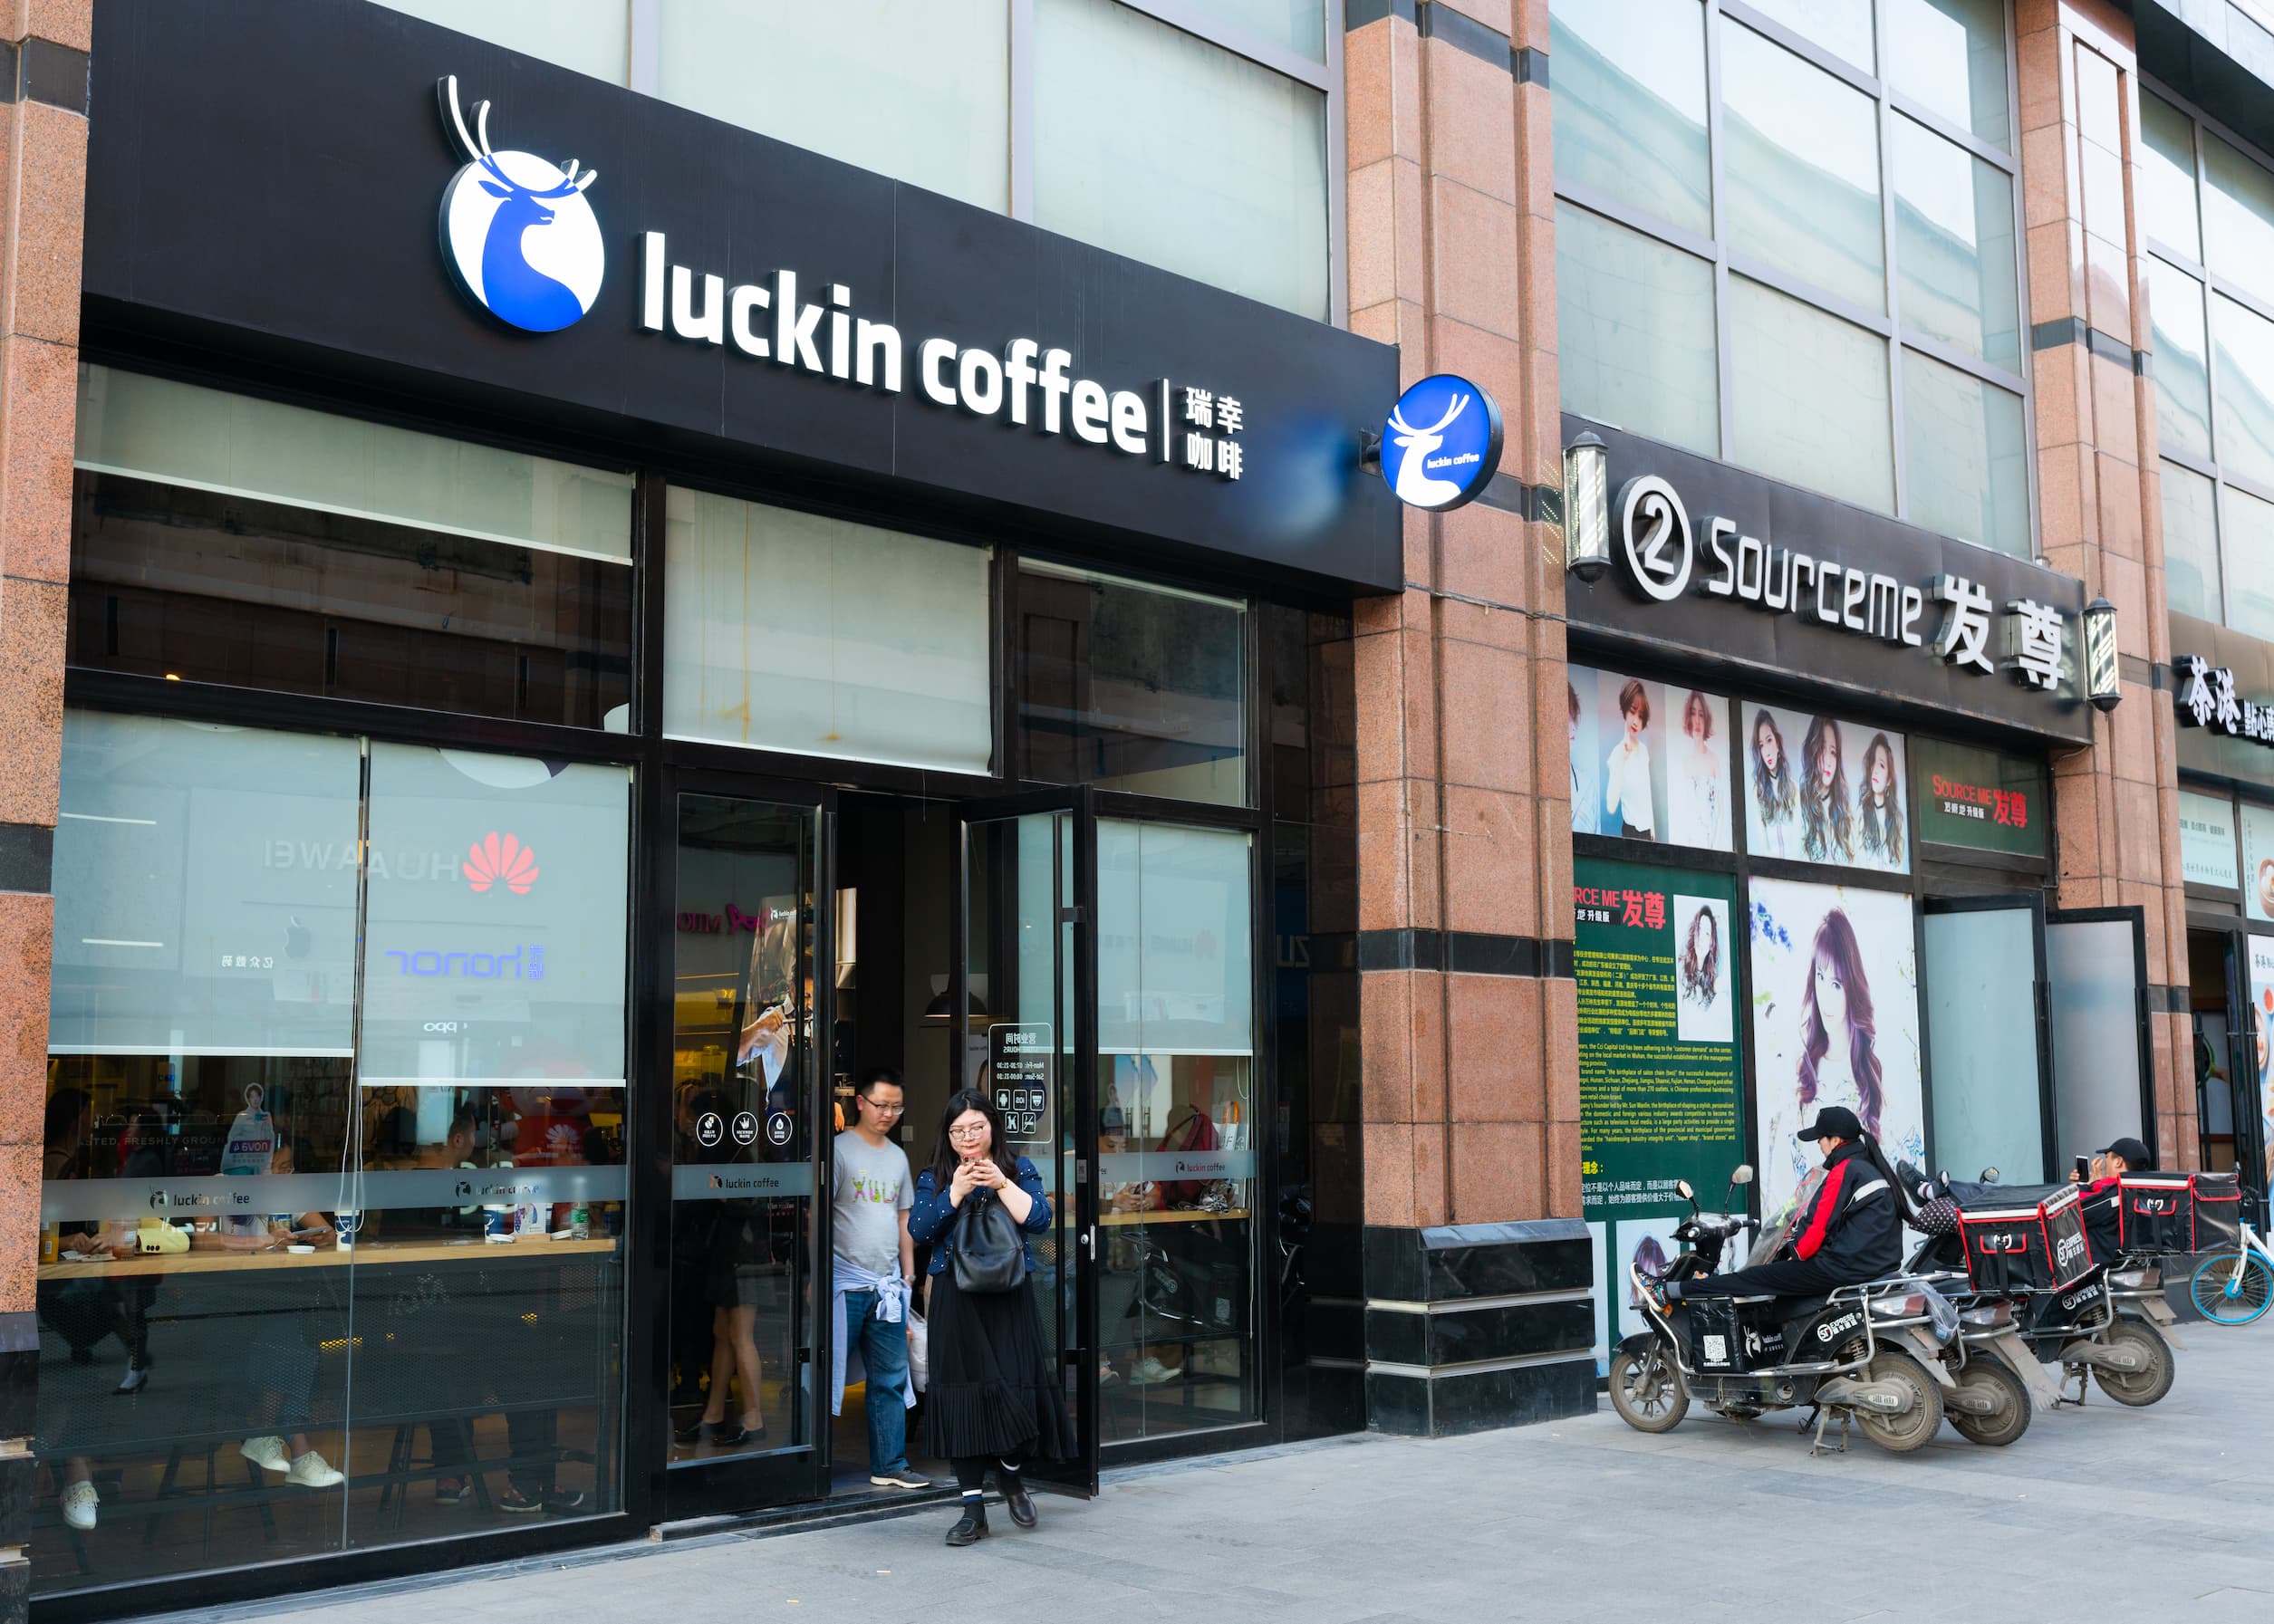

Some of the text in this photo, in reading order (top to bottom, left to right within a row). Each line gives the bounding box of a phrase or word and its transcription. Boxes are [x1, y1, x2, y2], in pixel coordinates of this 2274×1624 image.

[638, 232, 1147, 454] luckin coffee
[1185, 386, 1243, 435] 瑞幸
[1186, 431, 1243, 480] 咖啡
[1427, 453, 1479, 469] luckin coffee
[1942, 573, 2066, 690] 发尊
[1977, 787, 1992, 806] ME
[1993, 788, 2028, 829] 发尊
[1574, 886, 1621, 908] RCE ME
[1622, 889, 1666, 929] 发尊
[124, 1137, 178, 1145] FRESHLY
[1187, 1162, 1226, 1173] luckin coffee
[726, 1177, 780, 1189] luckin coffee
[173, 1193, 210, 1206] luckin
